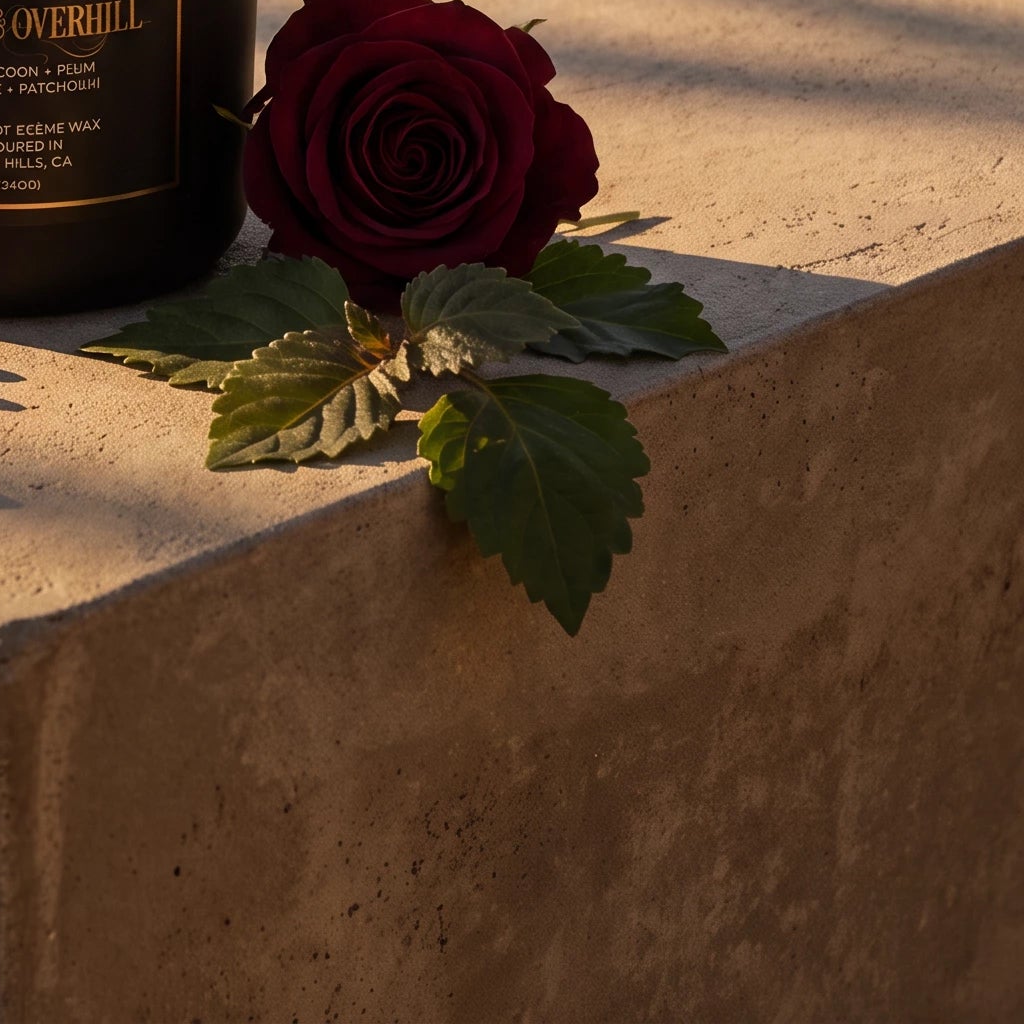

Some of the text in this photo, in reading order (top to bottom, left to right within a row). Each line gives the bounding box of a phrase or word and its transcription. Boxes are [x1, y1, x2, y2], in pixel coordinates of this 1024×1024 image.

[44, 68, 52, 76] +
[6, 86, 14, 94] +
[67, 118, 101, 133] WAX
[48, 139, 63, 151] IN
[4, 157, 48, 171] HILLS,
[51, 155, 73, 168] CA
